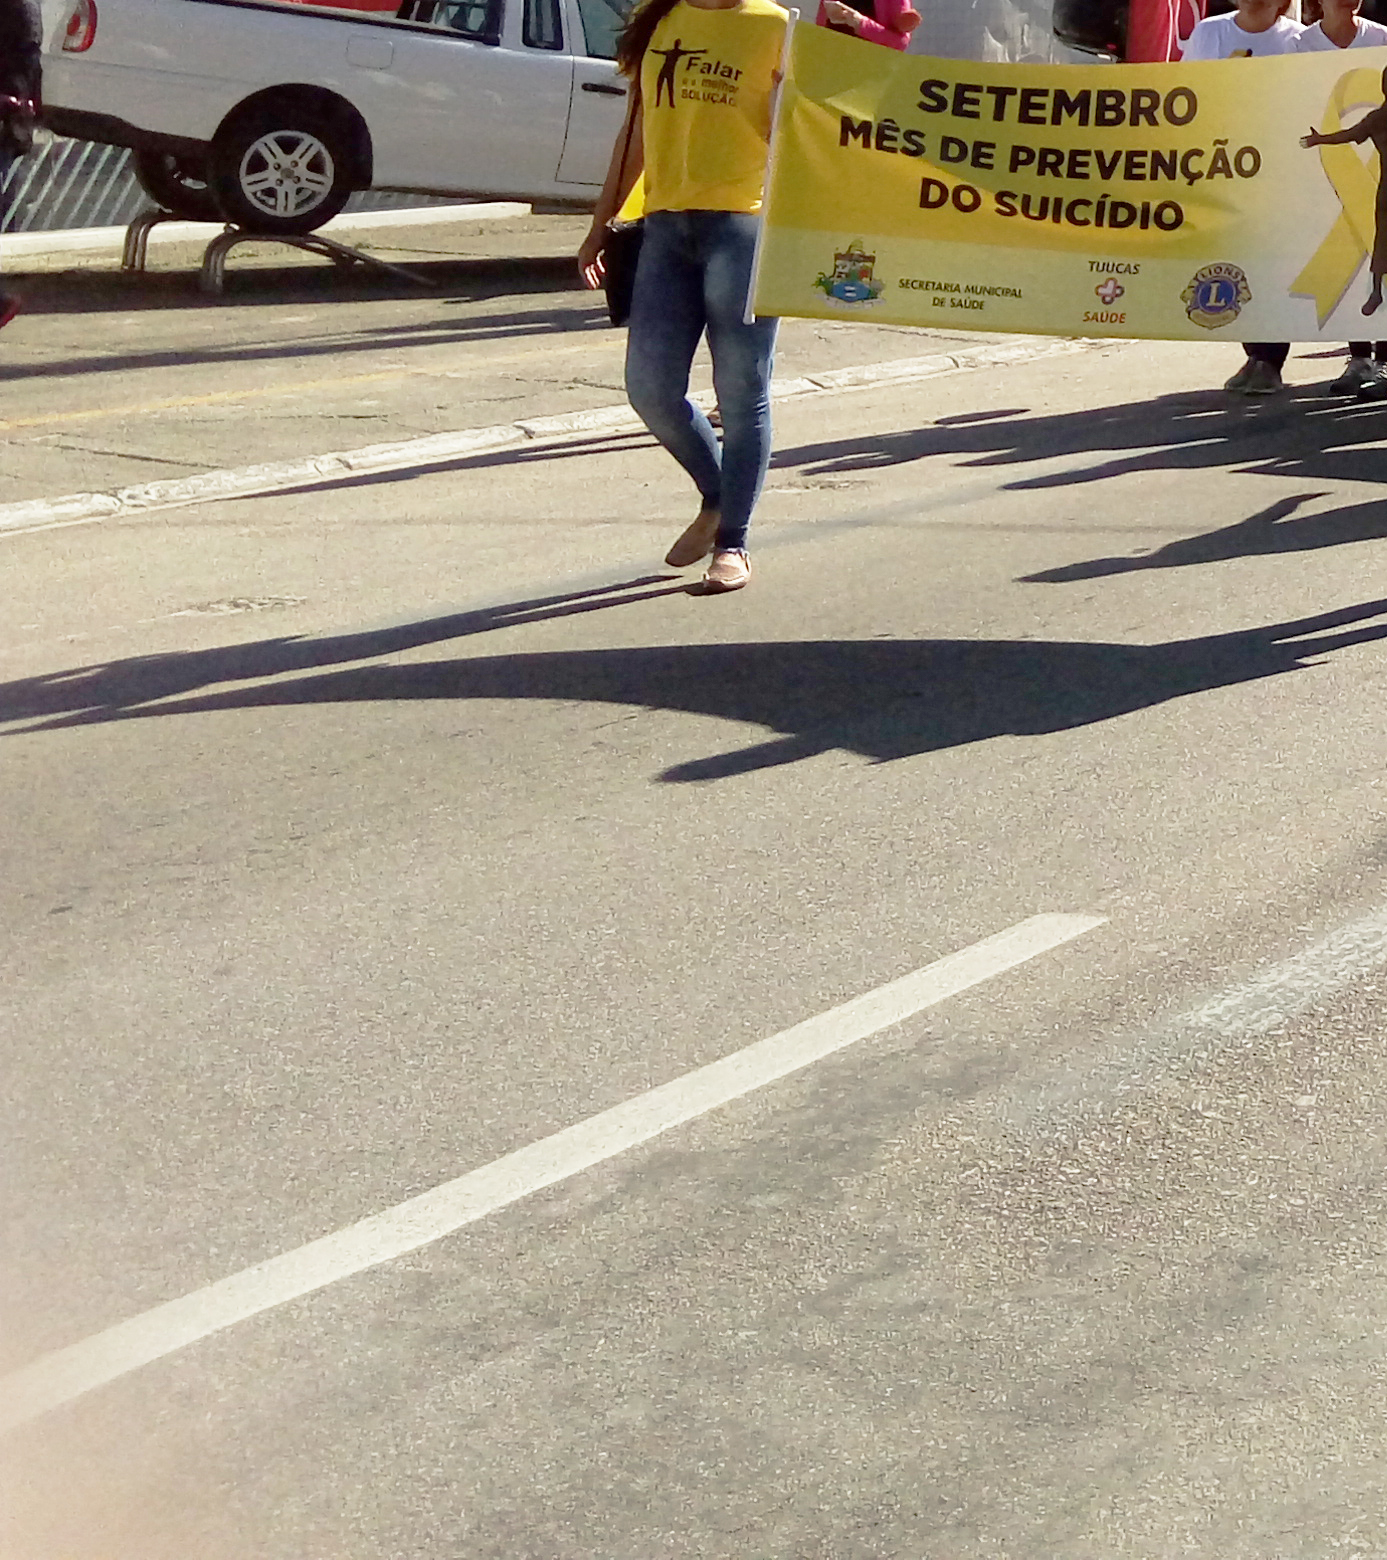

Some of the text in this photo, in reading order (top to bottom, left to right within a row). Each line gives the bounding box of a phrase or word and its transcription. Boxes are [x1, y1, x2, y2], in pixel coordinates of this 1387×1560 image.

[685, 56, 743, 82] Falar
[701, 77, 740, 93] melhor
[680, 87, 737, 108] SOLUÇÃO
[917, 78, 1199, 128] SETEMBRO
[838, 114, 1263, 186] MÊS DE PREVENÇÃO
[918, 177, 1185, 232] DO SUICÍDIO
[1087, 260, 1141, 276] TIJUCAS
[1199, 263, 1243, 282] LIONS
[898, 277, 1024, 300] SECRETARIA MUNICIPAL
[1206, 281, 1227, 308] L
[931, 295, 986, 311] DE SAÚDE
[1082, 309, 1127, 325] SAÚDE
